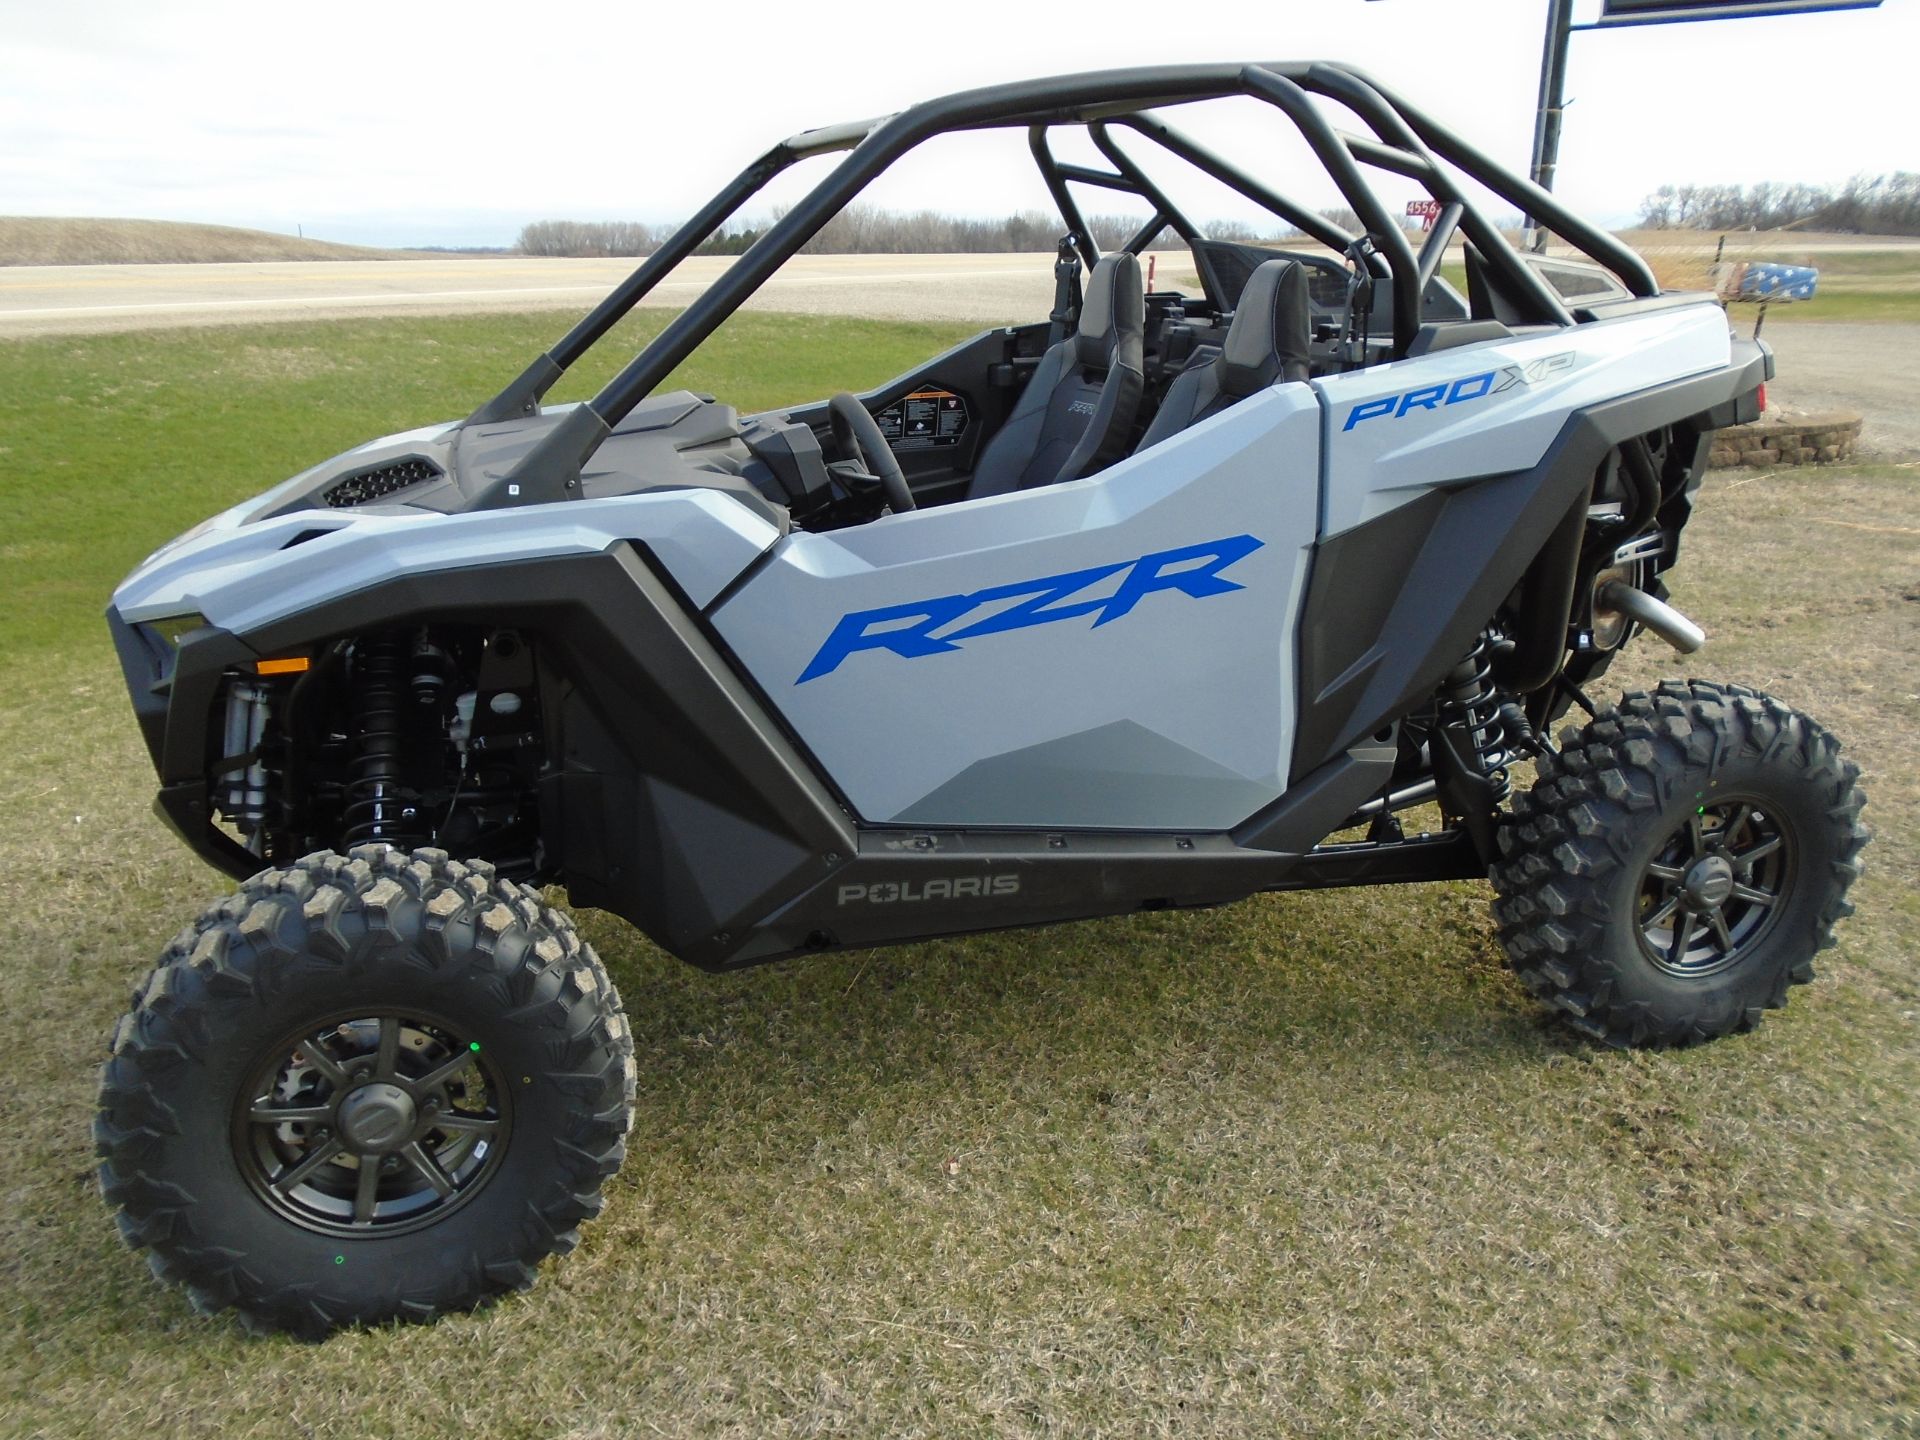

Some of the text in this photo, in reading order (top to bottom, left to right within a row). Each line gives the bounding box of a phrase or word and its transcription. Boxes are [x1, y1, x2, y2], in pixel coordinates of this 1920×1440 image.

[1407, 202, 1439, 214] 4556
[1342, 350, 1577, 432] PRO XP
[793, 534, 1266, 686] RZR
[837, 874, 1020, 905] POLARIS
